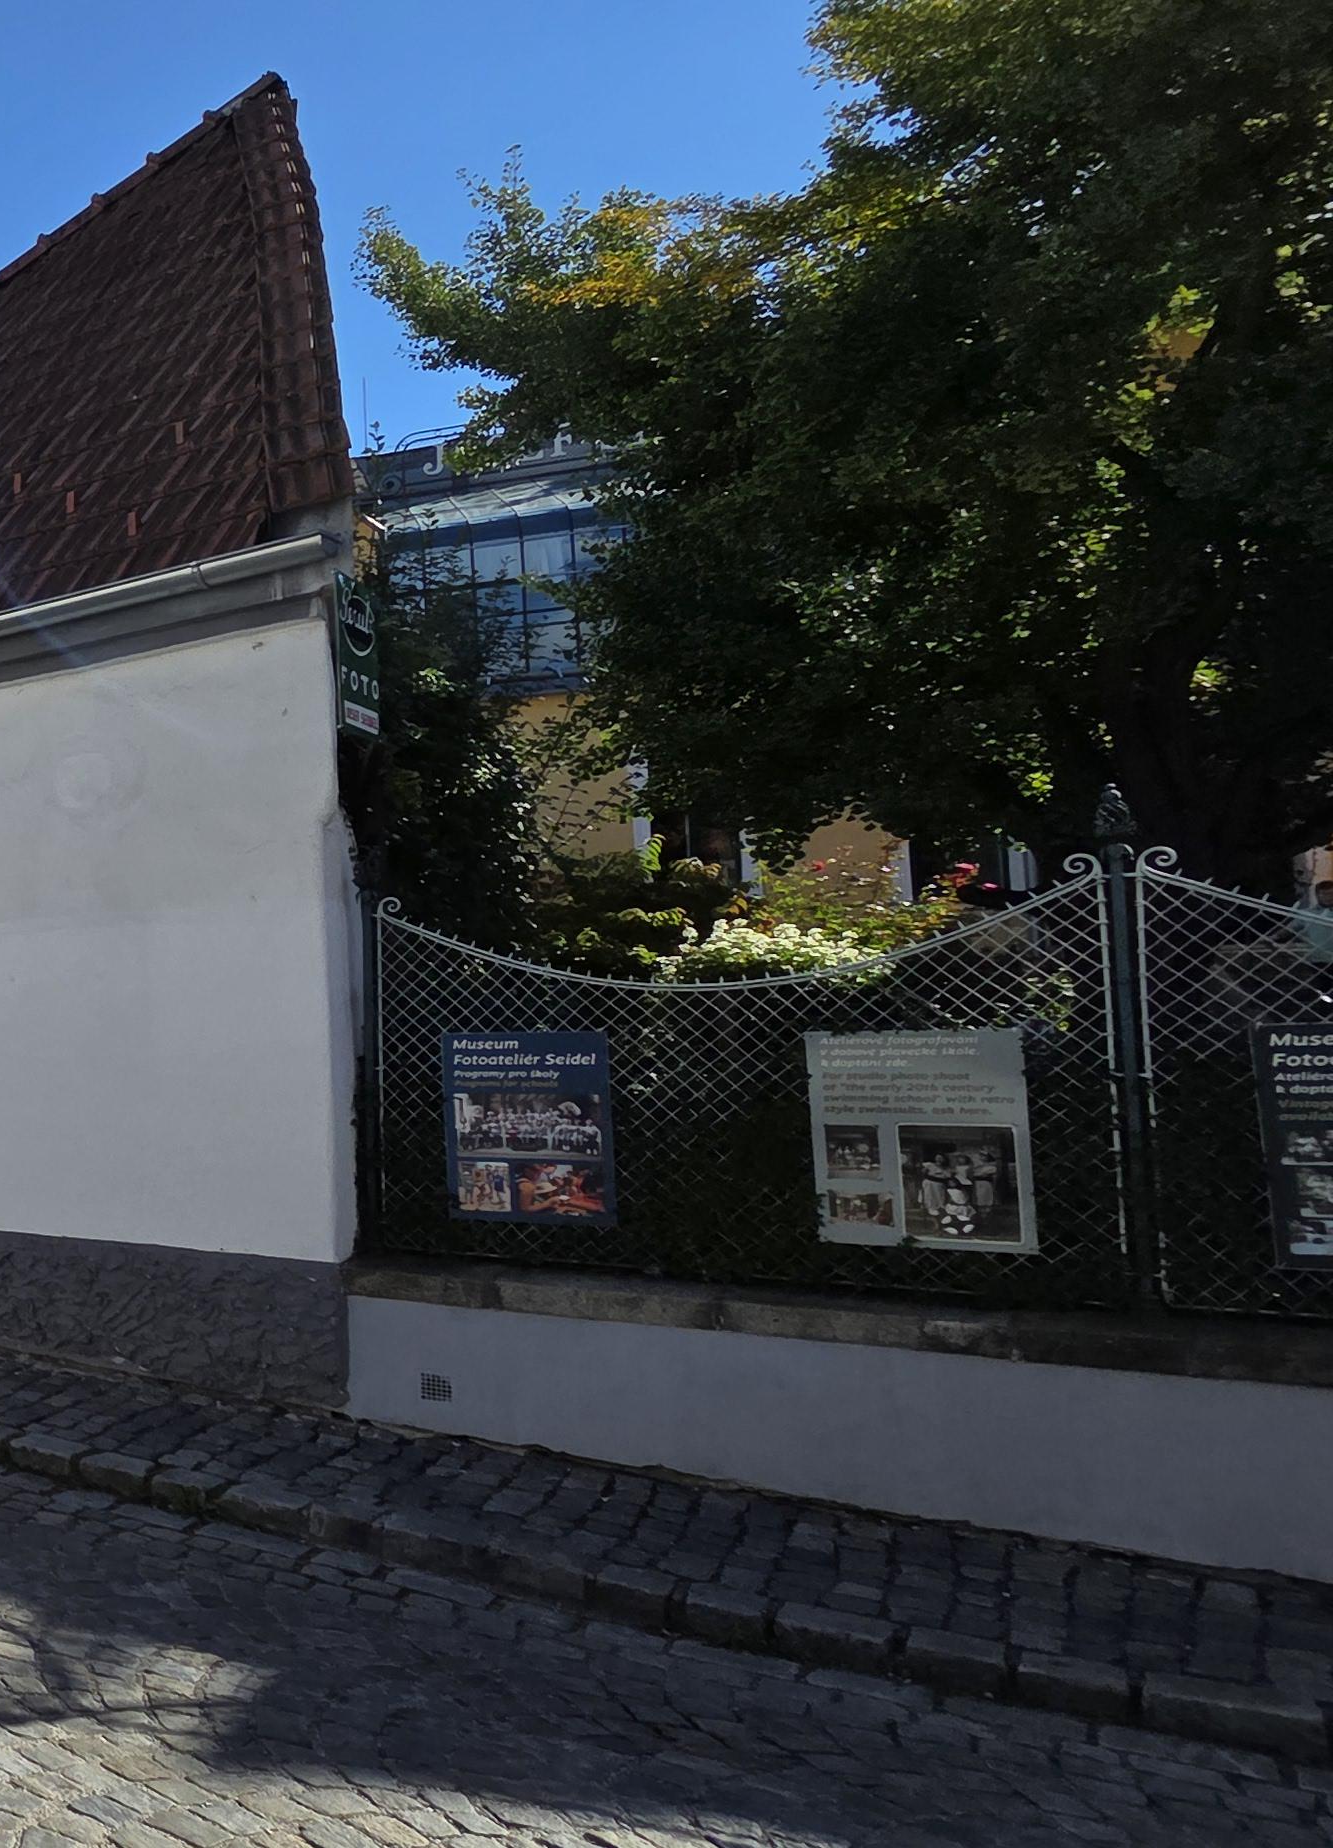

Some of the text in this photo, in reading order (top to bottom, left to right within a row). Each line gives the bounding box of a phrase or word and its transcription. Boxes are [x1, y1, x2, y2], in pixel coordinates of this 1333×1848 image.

[341, 665, 379, 700] FOTO
[452, 1039, 519, 1050] Museum
[453, 1053, 596, 1065] Fotoateliér Seidel
[453, 1070, 506, 1080] Programy
[508, 1070, 527, 1079] pro
[891, 1071, 930, 1081] photo
[933, 1071, 970, 1080] shoot
[942, 1084, 996, 1093] century
[823, 1094, 889, 1104] swimming
[946, 1095, 976, 1103] with
[981, 1096, 1015, 1104] retro
